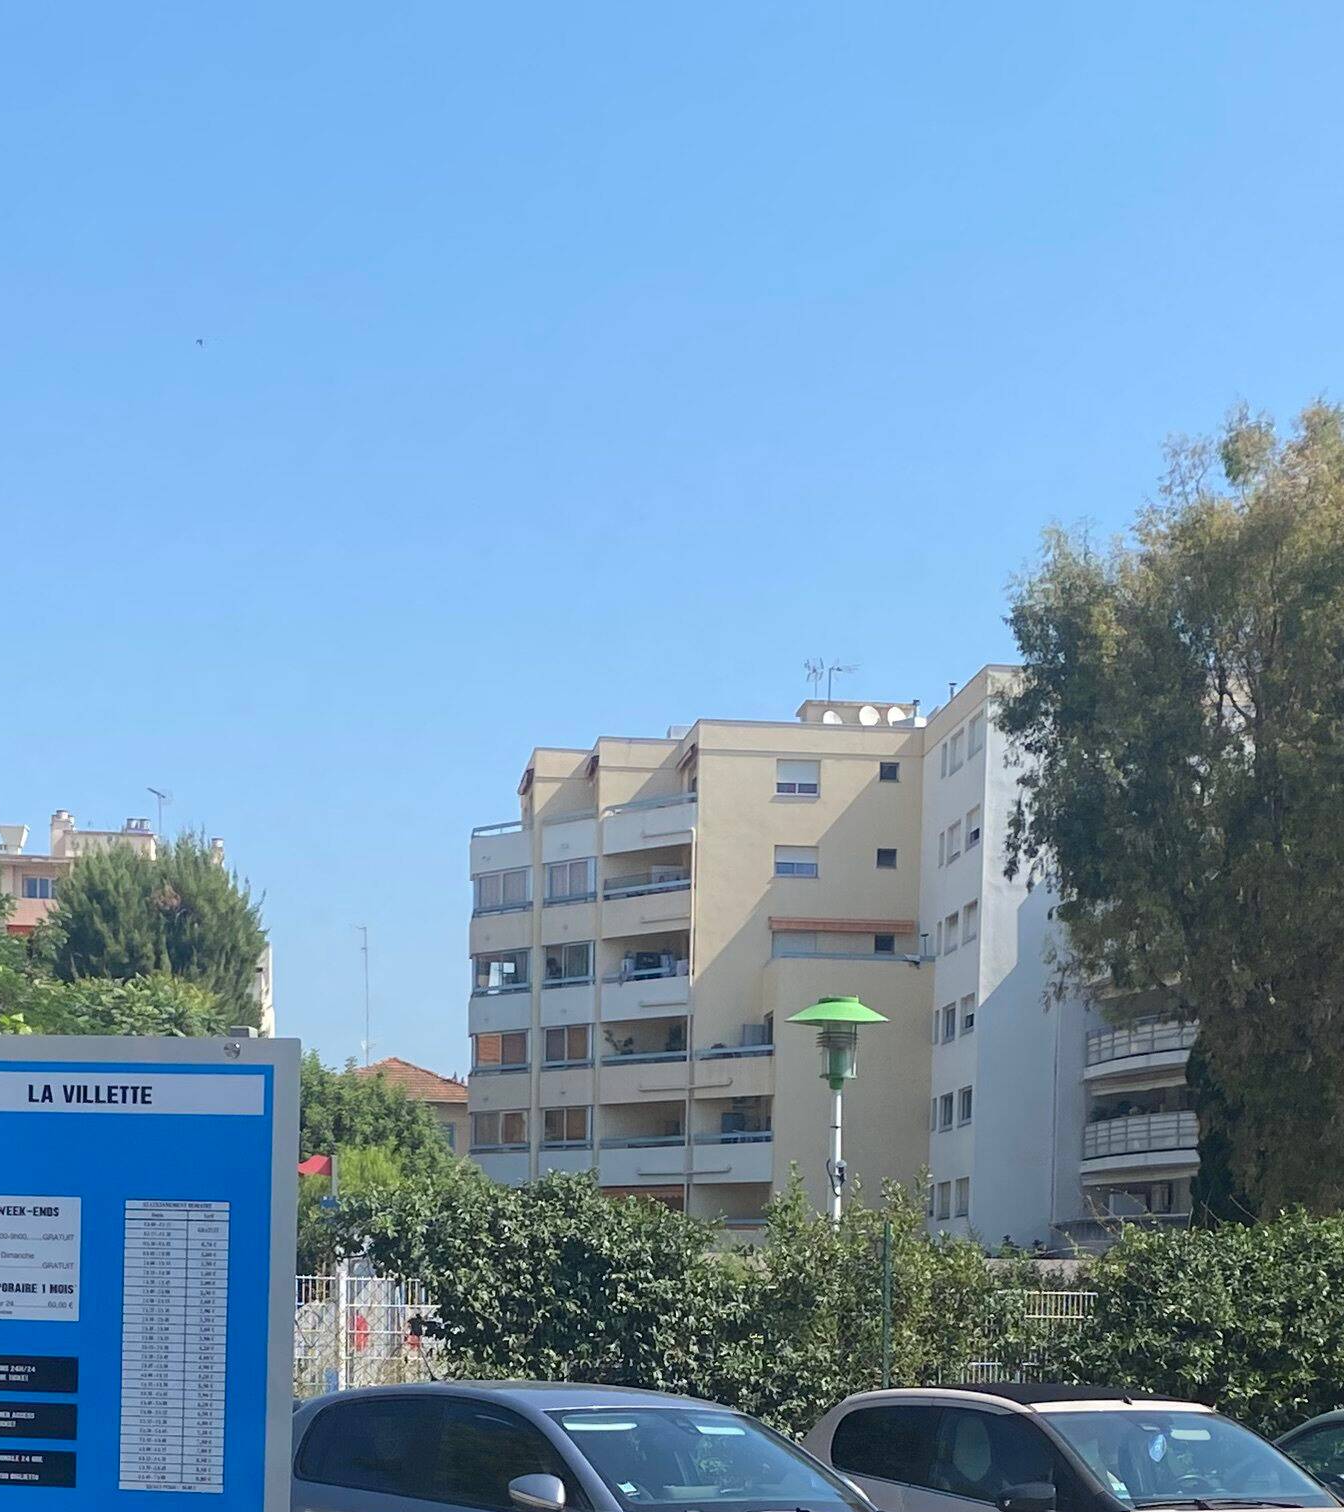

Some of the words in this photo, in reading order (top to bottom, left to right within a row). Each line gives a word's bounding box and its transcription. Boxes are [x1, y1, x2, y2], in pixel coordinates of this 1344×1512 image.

[28, 1085, 53, 1104] LA
[63, 1085, 153, 1105] VILLETTE
[50, 1284, 74, 1294] MOIS
